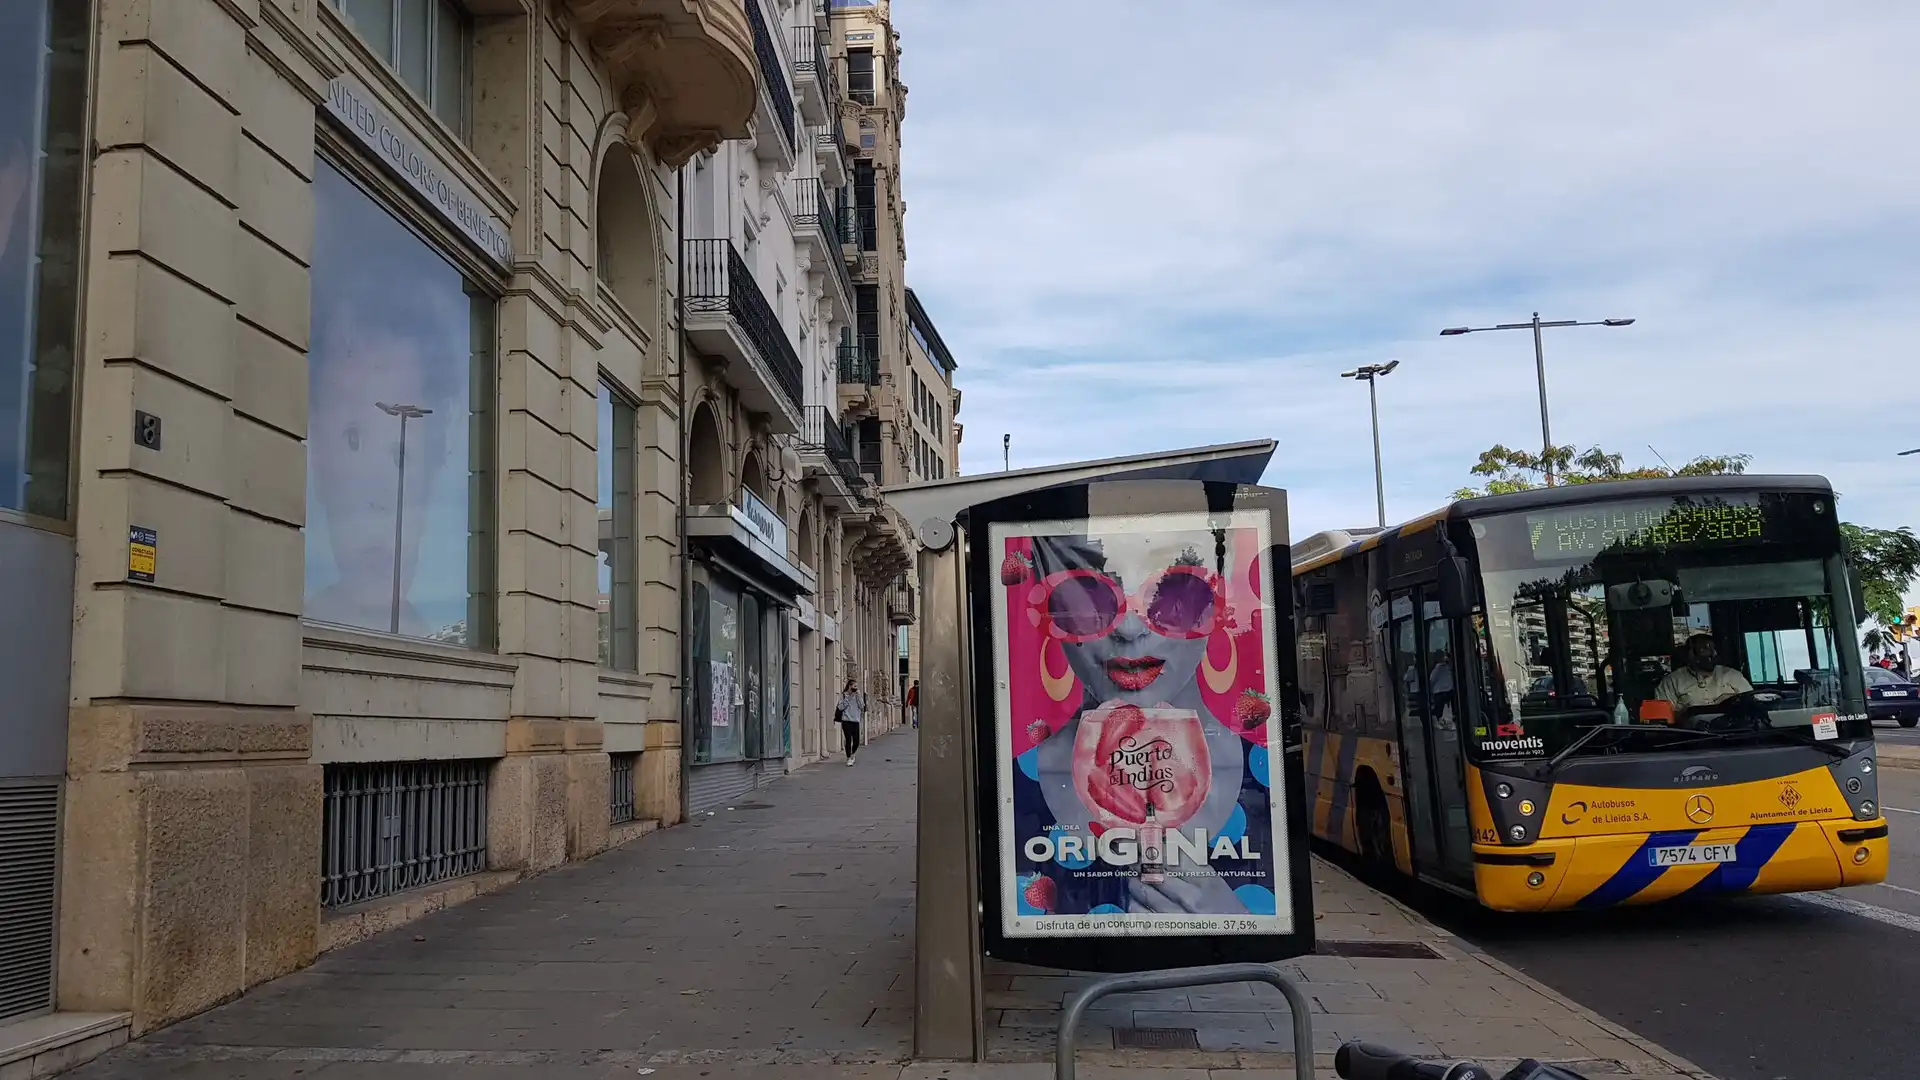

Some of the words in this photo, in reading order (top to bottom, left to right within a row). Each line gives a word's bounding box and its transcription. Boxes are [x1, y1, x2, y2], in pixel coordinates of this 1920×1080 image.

[327, 80, 376, 139] NITED
[379, 124, 436, 195] COLORS
[437, 179, 455, 211] OF
[456, 195, 516, 266] BENETTON
[143, 414, 156, 445] 8
[1481, 736, 1544, 751] moventis
[1109, 737, 1173, 774] Puerto
[1118, 765, 1174, 791] Indias
[1673, 774, 1719, 783] HISPANO
[1591, 799, 1635, 809] Autobusos
[1592, 815, 1603, 824] de
[1605, 814, 1632, 823] Lleida
[1633, 812, 1651, 821] S.A.
[1750, 809, 1796, 820] Ajuntament
[1810, 806, 1833, 814] Lleida
[1659, 847, 1697, 863] 7574
[1703, 845, 1731, 861] CFY
[1114, 869, 1139, 877] ÚNICO
[1036, 920, 1075, 931] Disfruta
[1077, 919, 1091, 929] de
[1093, 921, 1106, 929] un
[1107, 920, 1152, 929] consumo
[1154, 920, 1220, 930] responsable.
[1223, 919, 1258, 931] 37,5%
